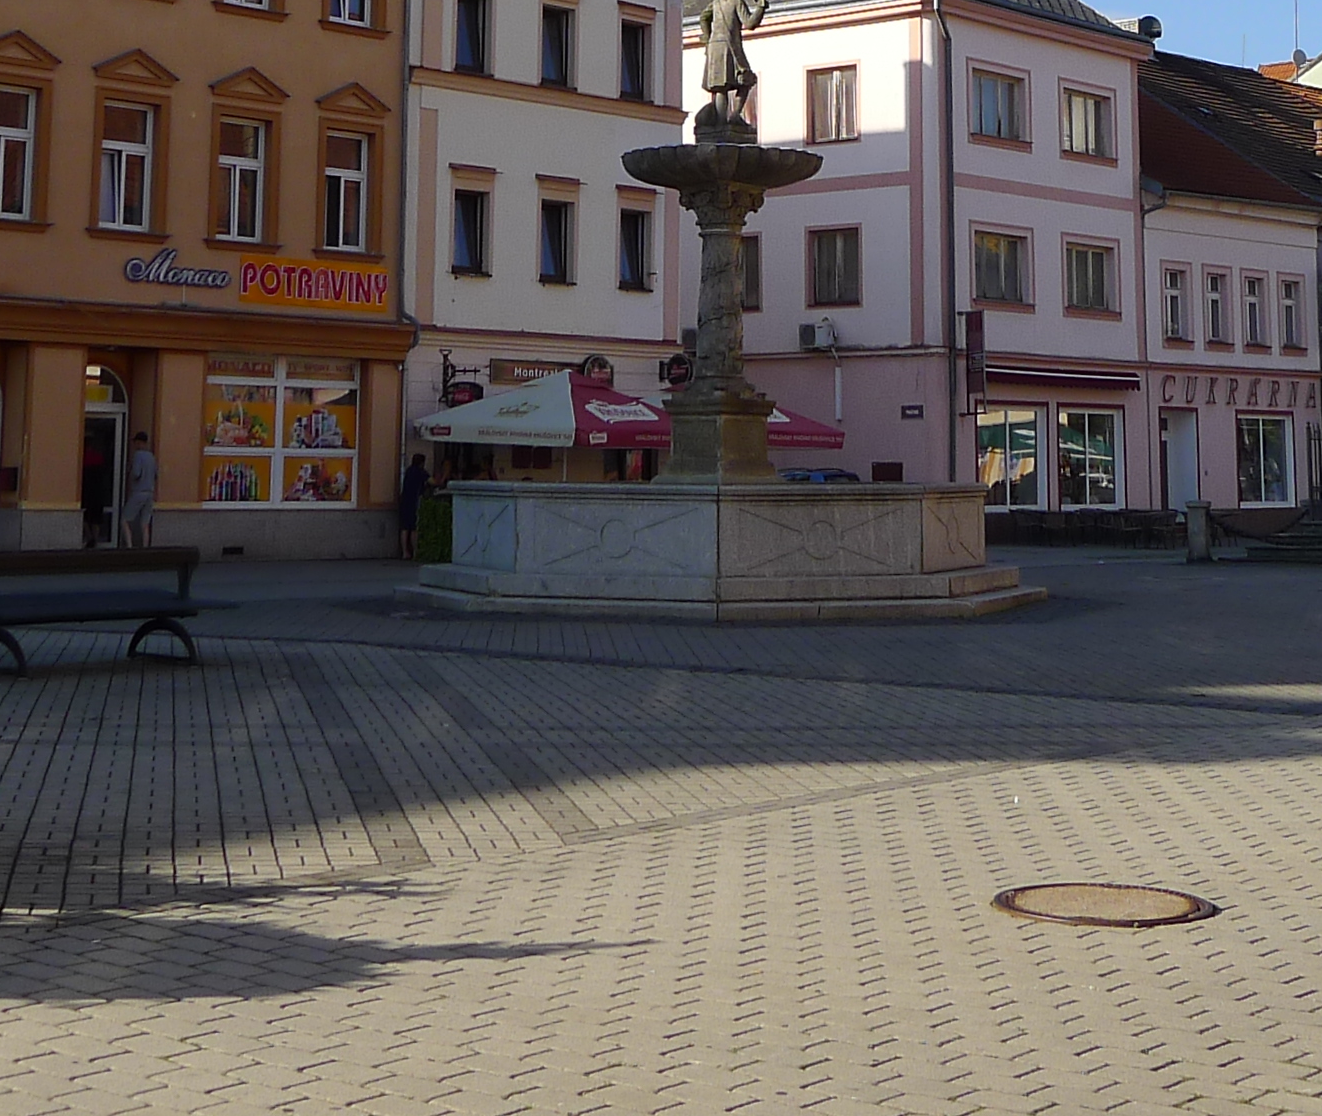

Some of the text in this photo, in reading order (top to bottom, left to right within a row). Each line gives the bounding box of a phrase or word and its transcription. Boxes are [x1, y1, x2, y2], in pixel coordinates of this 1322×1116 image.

[124, 247, 232, 289] Monaco
[240, 261, 389, 306] POTRAVINY
[1161, 374, 1317, 409] CUKRÁRNA
